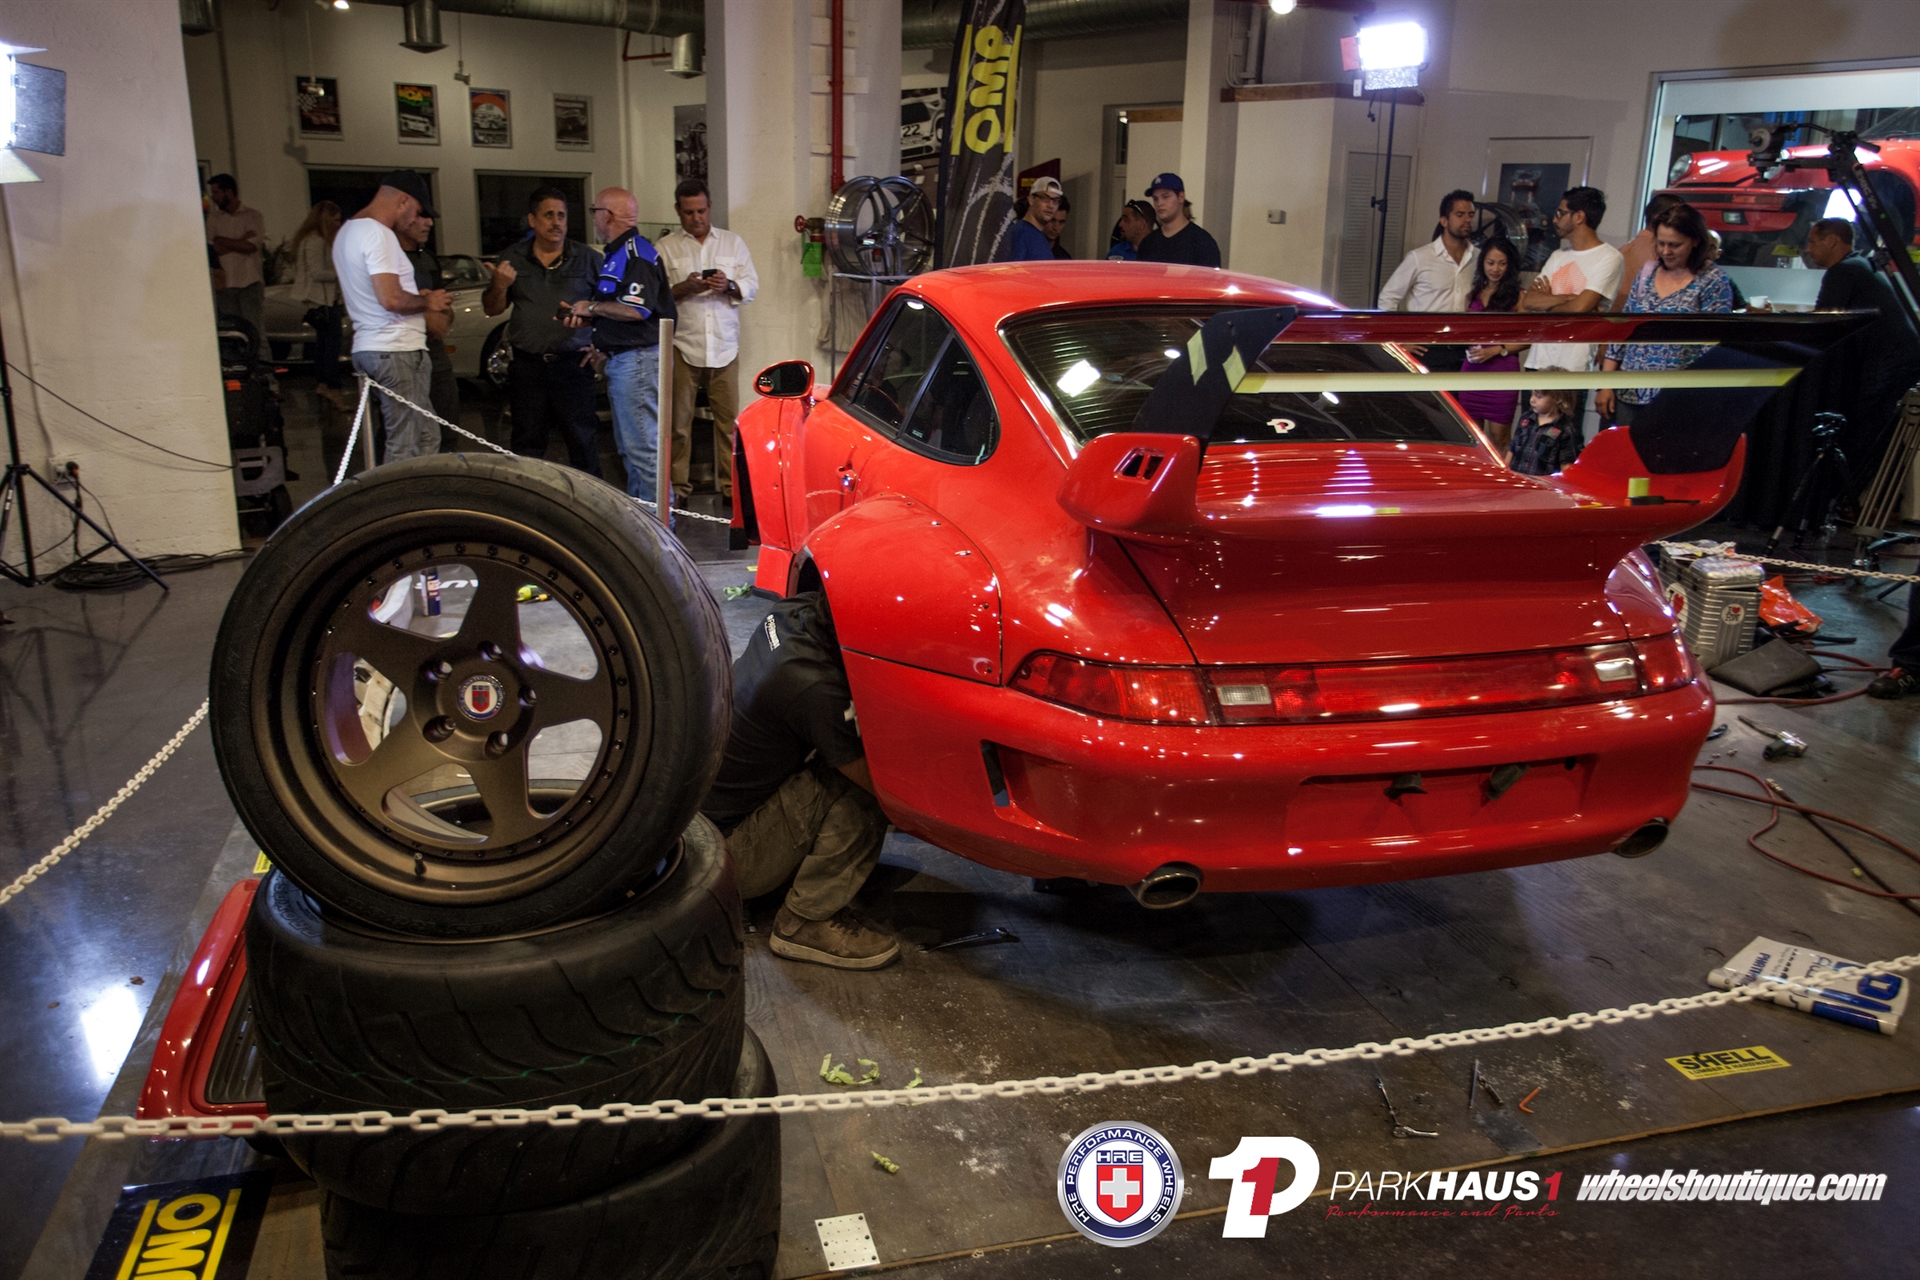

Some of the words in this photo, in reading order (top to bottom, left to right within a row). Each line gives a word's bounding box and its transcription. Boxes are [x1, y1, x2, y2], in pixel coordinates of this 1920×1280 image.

[965, 25, 1013, 154] OMP
[902, 124, 921, 138] 22
[1676, 1049, 1772, 1070] SHELL
